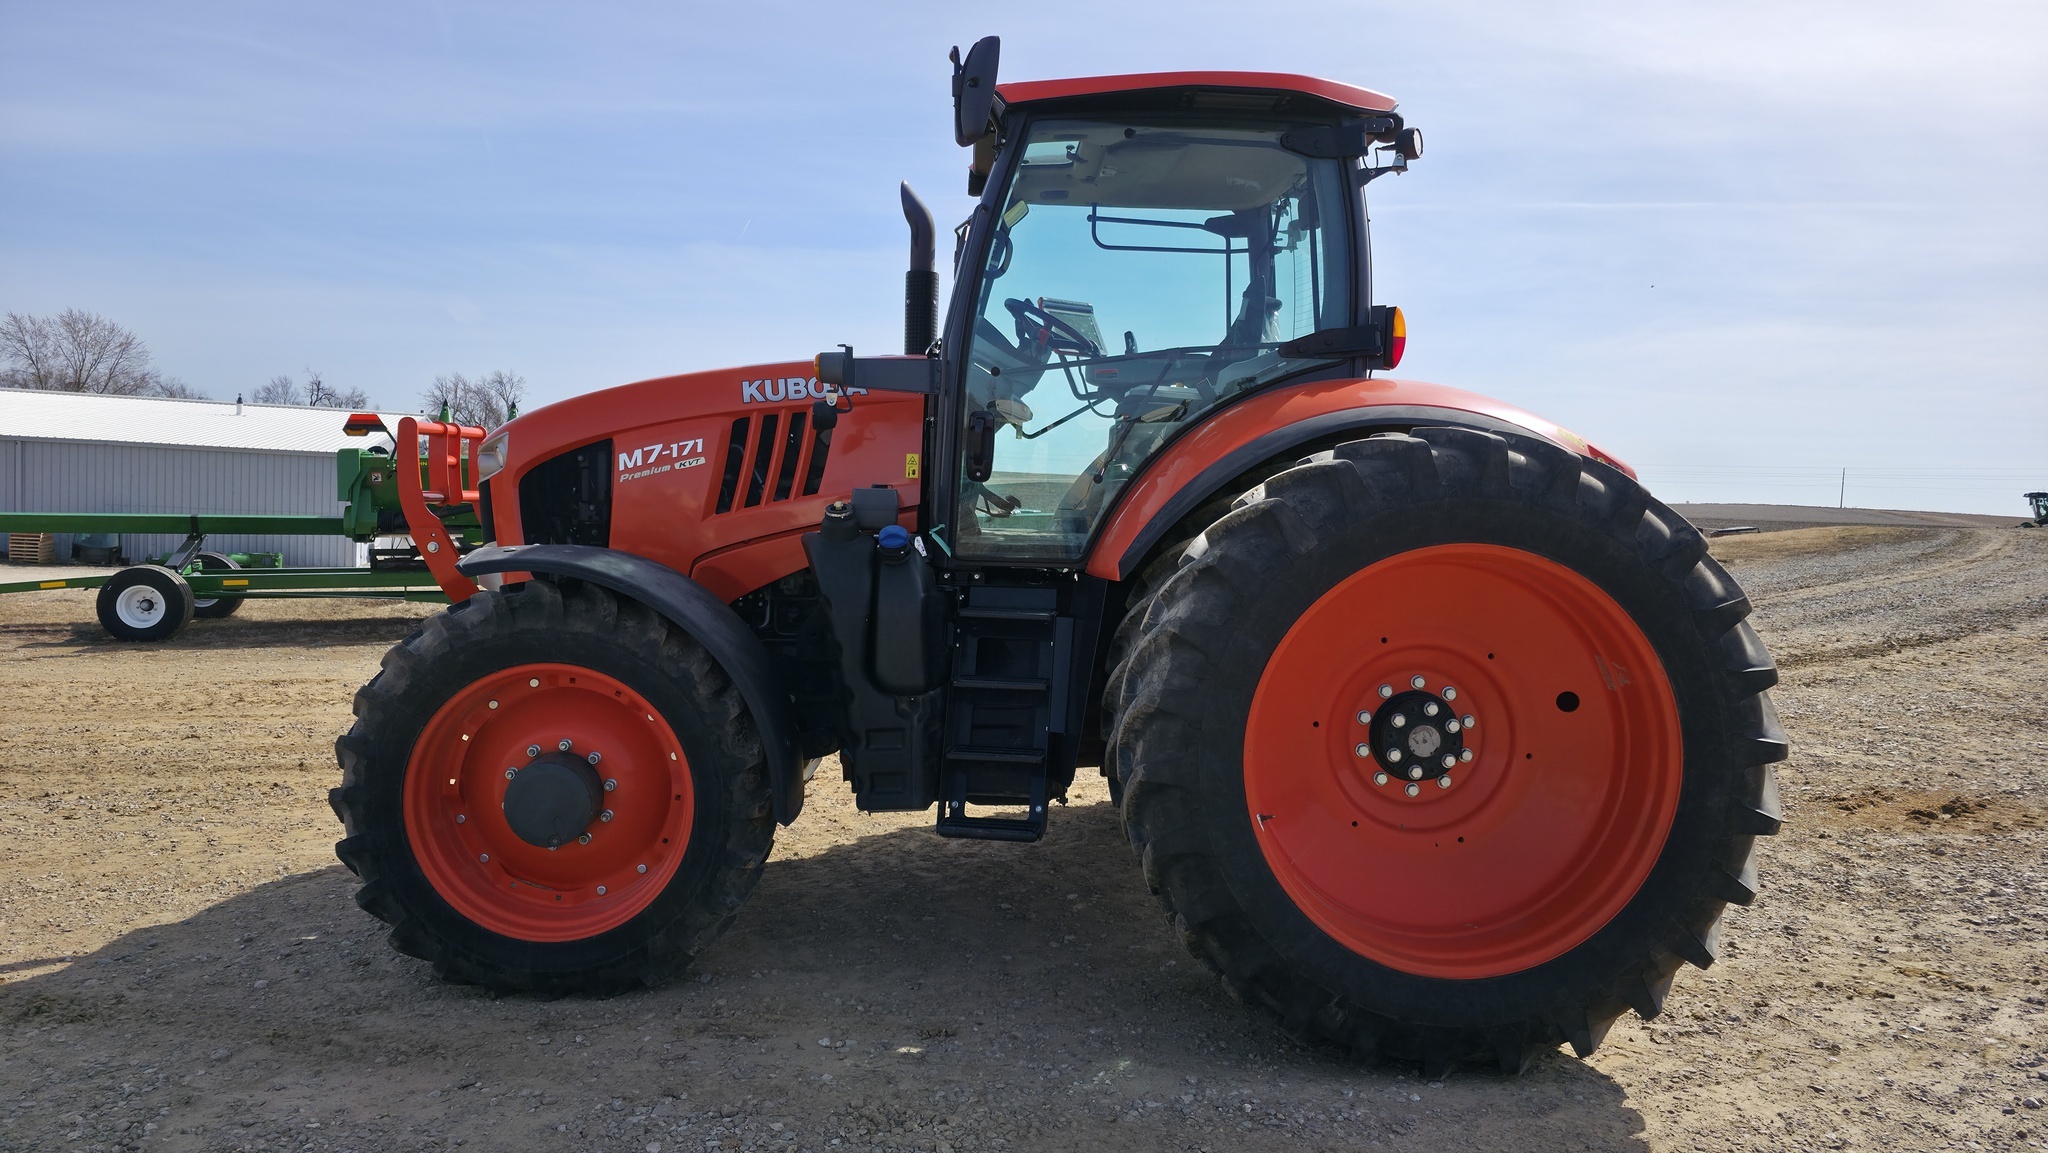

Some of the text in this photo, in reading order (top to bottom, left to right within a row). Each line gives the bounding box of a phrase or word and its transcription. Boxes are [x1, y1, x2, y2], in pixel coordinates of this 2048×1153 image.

[741, 376, 869, 403] KUBO
[618, 438, 703, 471] M7-171
[620, 458, 701, 483] Premium KVT
